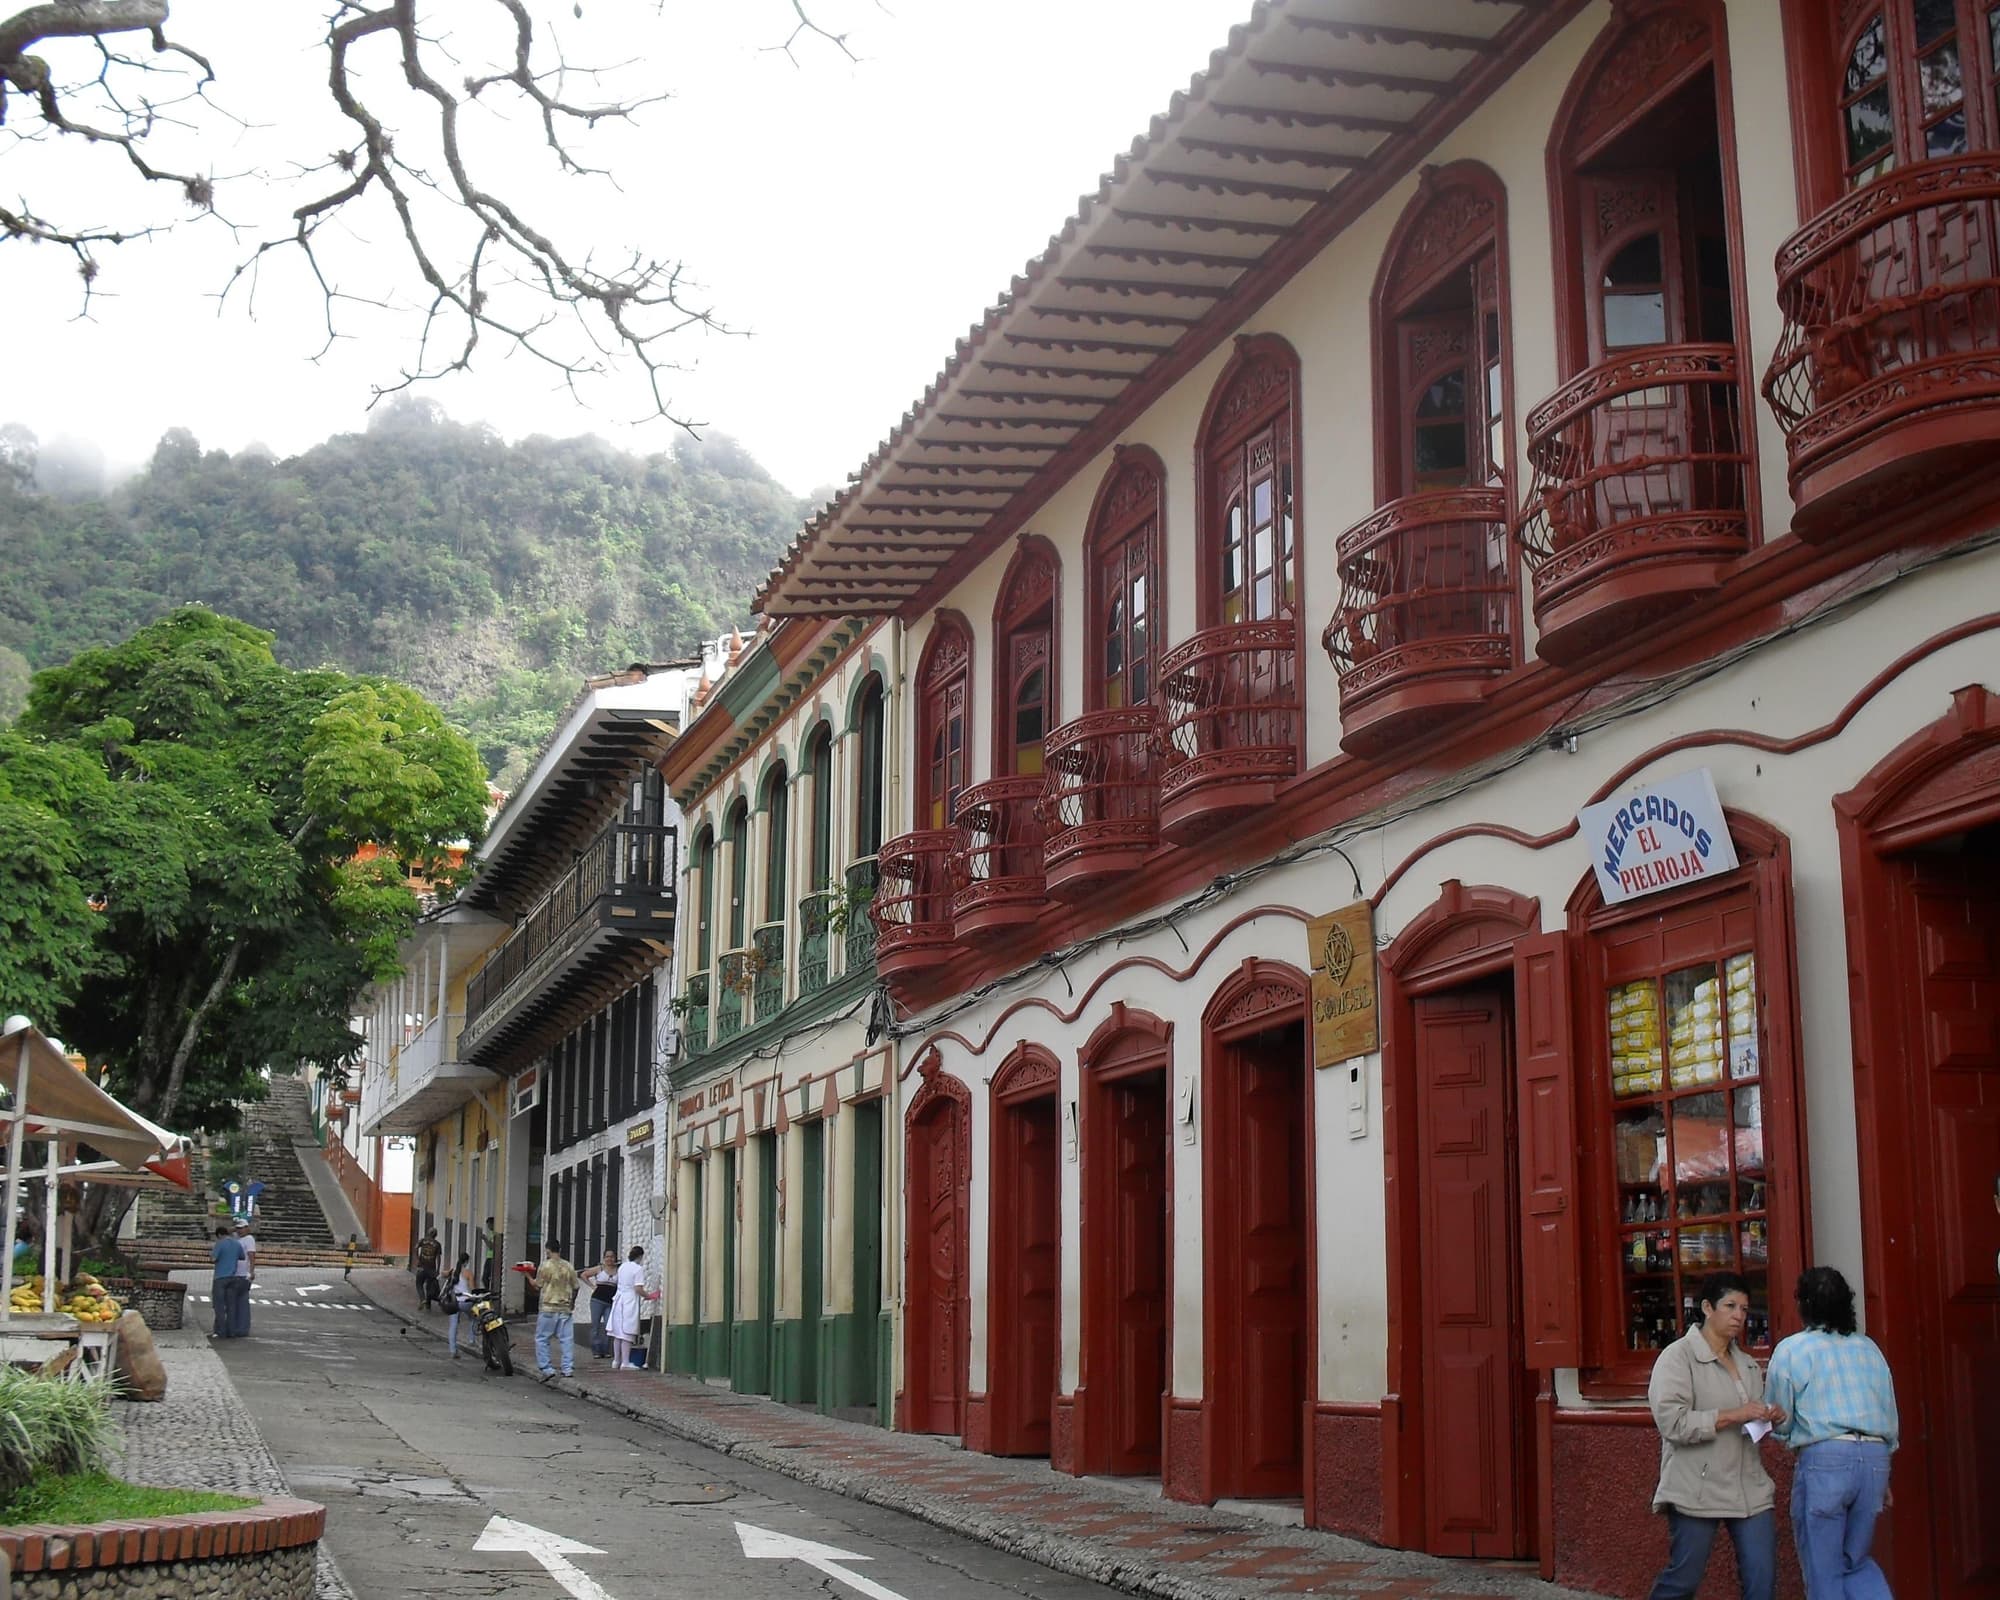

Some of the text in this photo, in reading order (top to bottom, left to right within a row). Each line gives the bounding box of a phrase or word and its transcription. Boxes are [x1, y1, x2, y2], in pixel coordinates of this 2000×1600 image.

[1604, 795, 1712, 884] MERCADOS
[1637, 826, 1661, 854] EL
[1619, 849, 1704, 894] PIELROJA
